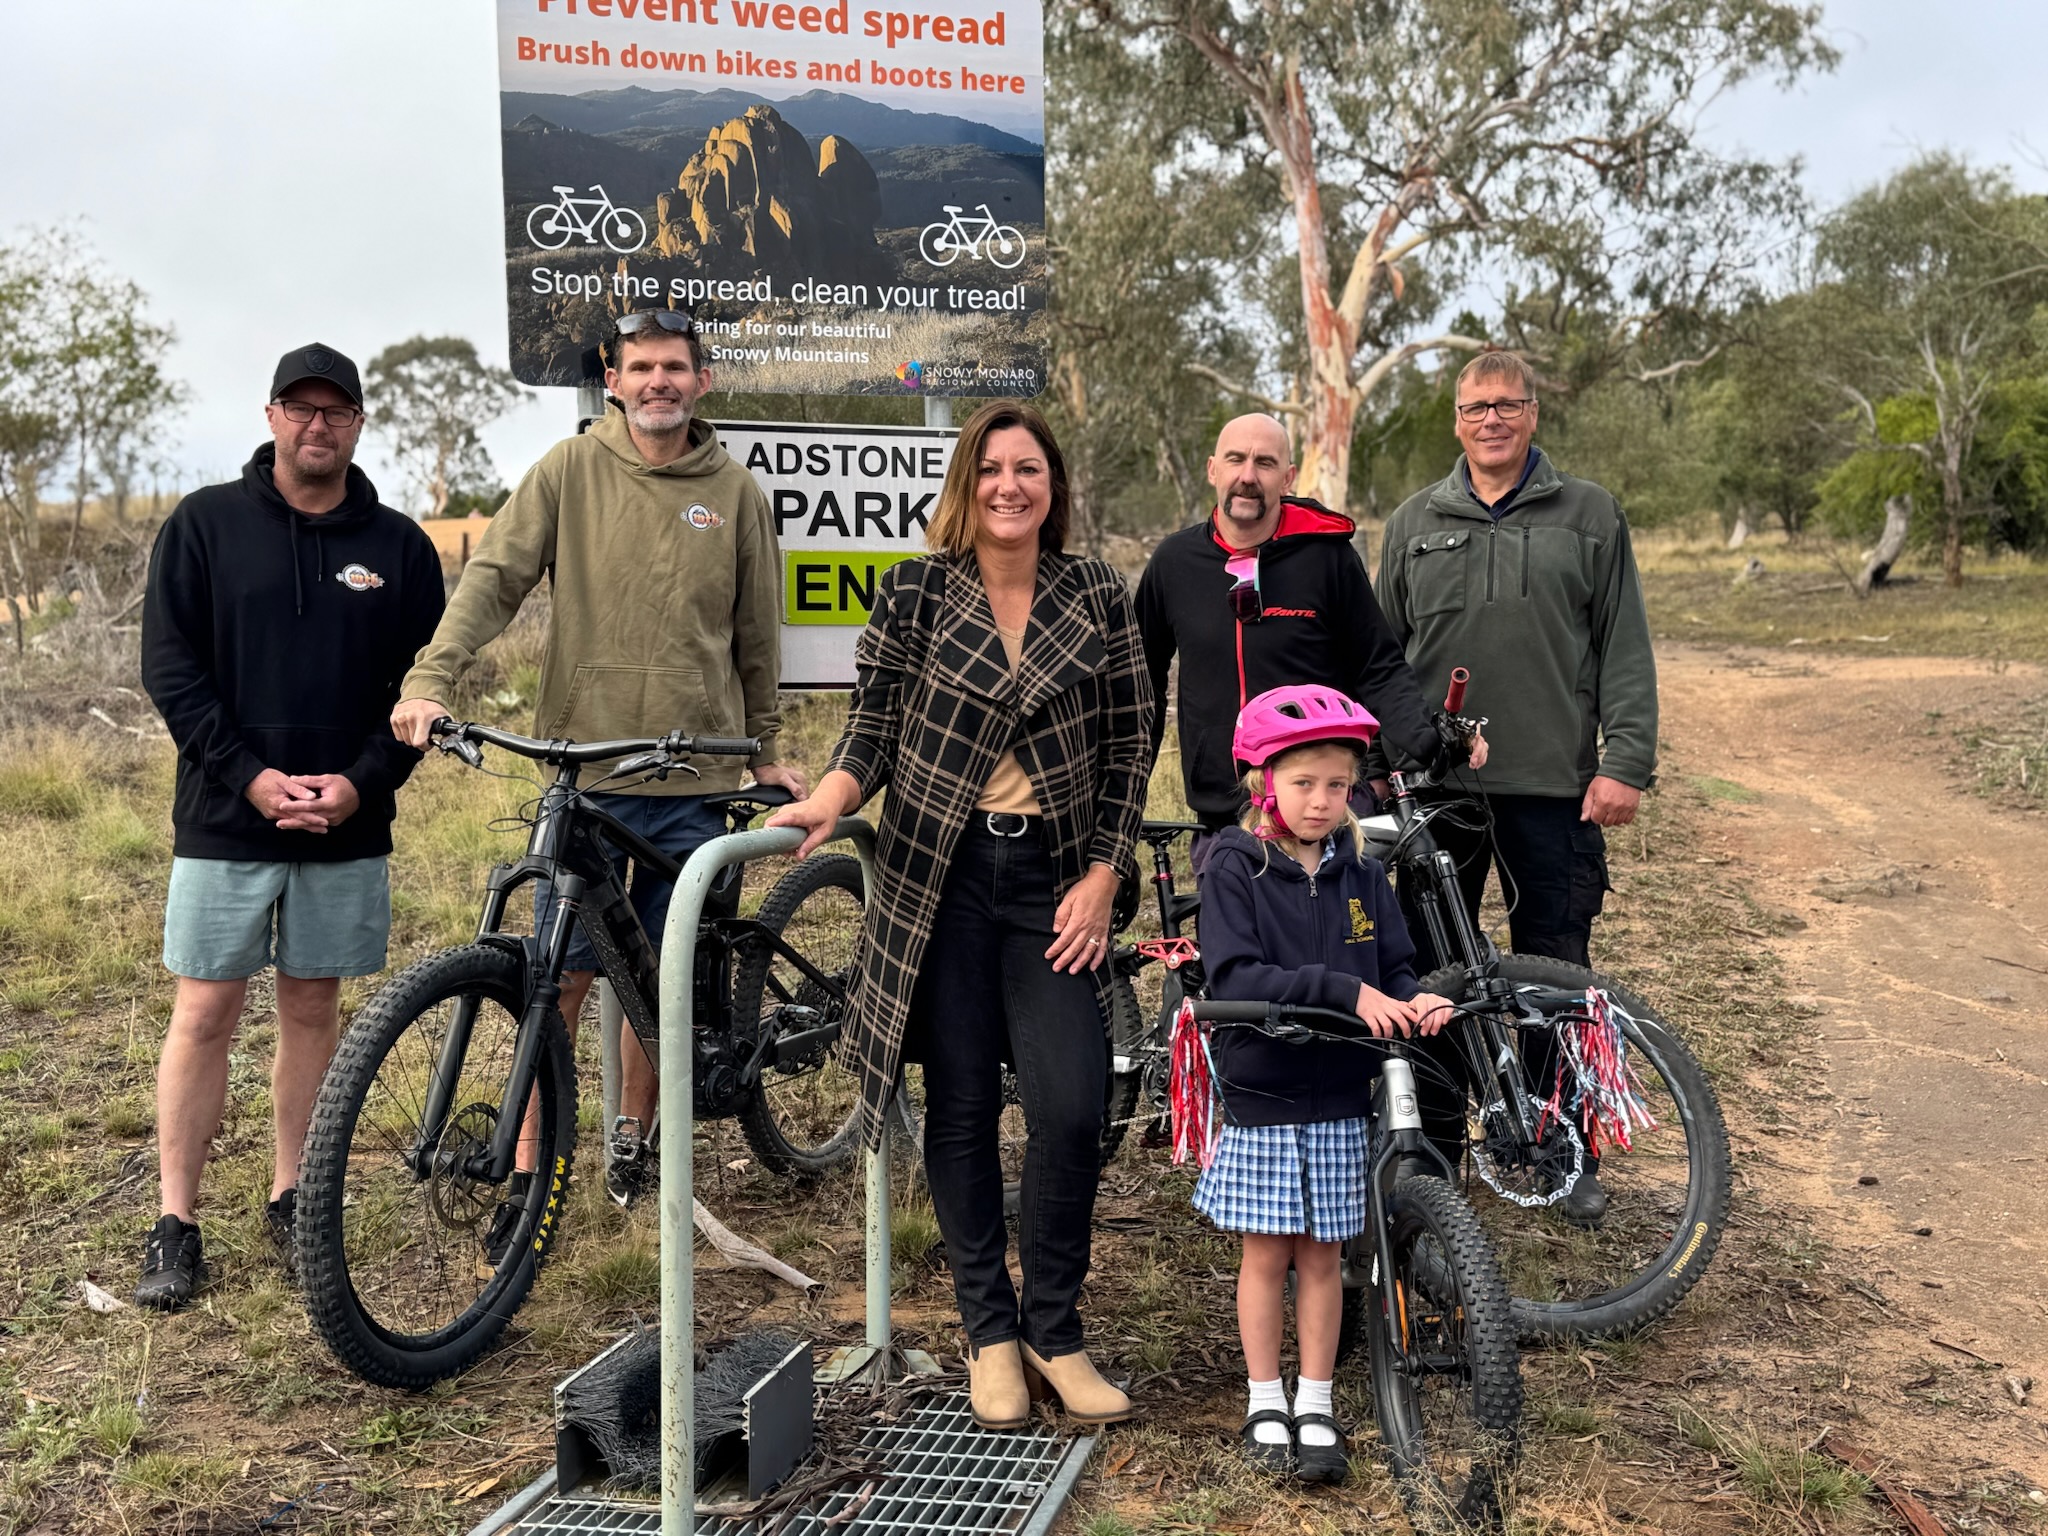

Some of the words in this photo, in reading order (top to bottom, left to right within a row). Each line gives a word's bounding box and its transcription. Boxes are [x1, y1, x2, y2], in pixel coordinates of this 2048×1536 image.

[731, 0, 849, 35] weed
[863, 12, 1006, 48] spread
[517, 36, 611, 66] Brush
[620, 43, 706, 73] down
[716, 49, 798, 79] bikes
[806, 59, 861, 84] and
[871, 60, 952, 89] boots
[961, 67, 1026, 94] here
[530, 267, 602, 303] Stop
[612, 270, 660, 298] the
[670, 275, 780, 306] spread,
[791, 277, 867, 305] clean
[876, 285, 939, 312] your
[947, 284, 1026, 310] tread!
[689, 317, 741, 339] aring
[745, 319, 772, 335] for
[776, 323, 807, 337] our
[812, 322, 892, 339] beautiful
[711, 345, 770, 364] Snowy
[775, 347, 870, 364] Mountains
[925, 367, 974, 378] SNOWY
[978, 368, 1035, 380] MONARO
[926, 378, 981, 387] REGIONAL
[987, 379, 1036, 388] COUNCIL
[720, 441, 945, 479] ADSTONE
[773, 489, 938, 538] PARK
[796, 564, 876, 611] EN
[1263, 607, 1317, 618] FANTIC
[534, 1155, 566, 1252] MAXXIS
[1672, 1222, 1709, 1274] Continental
